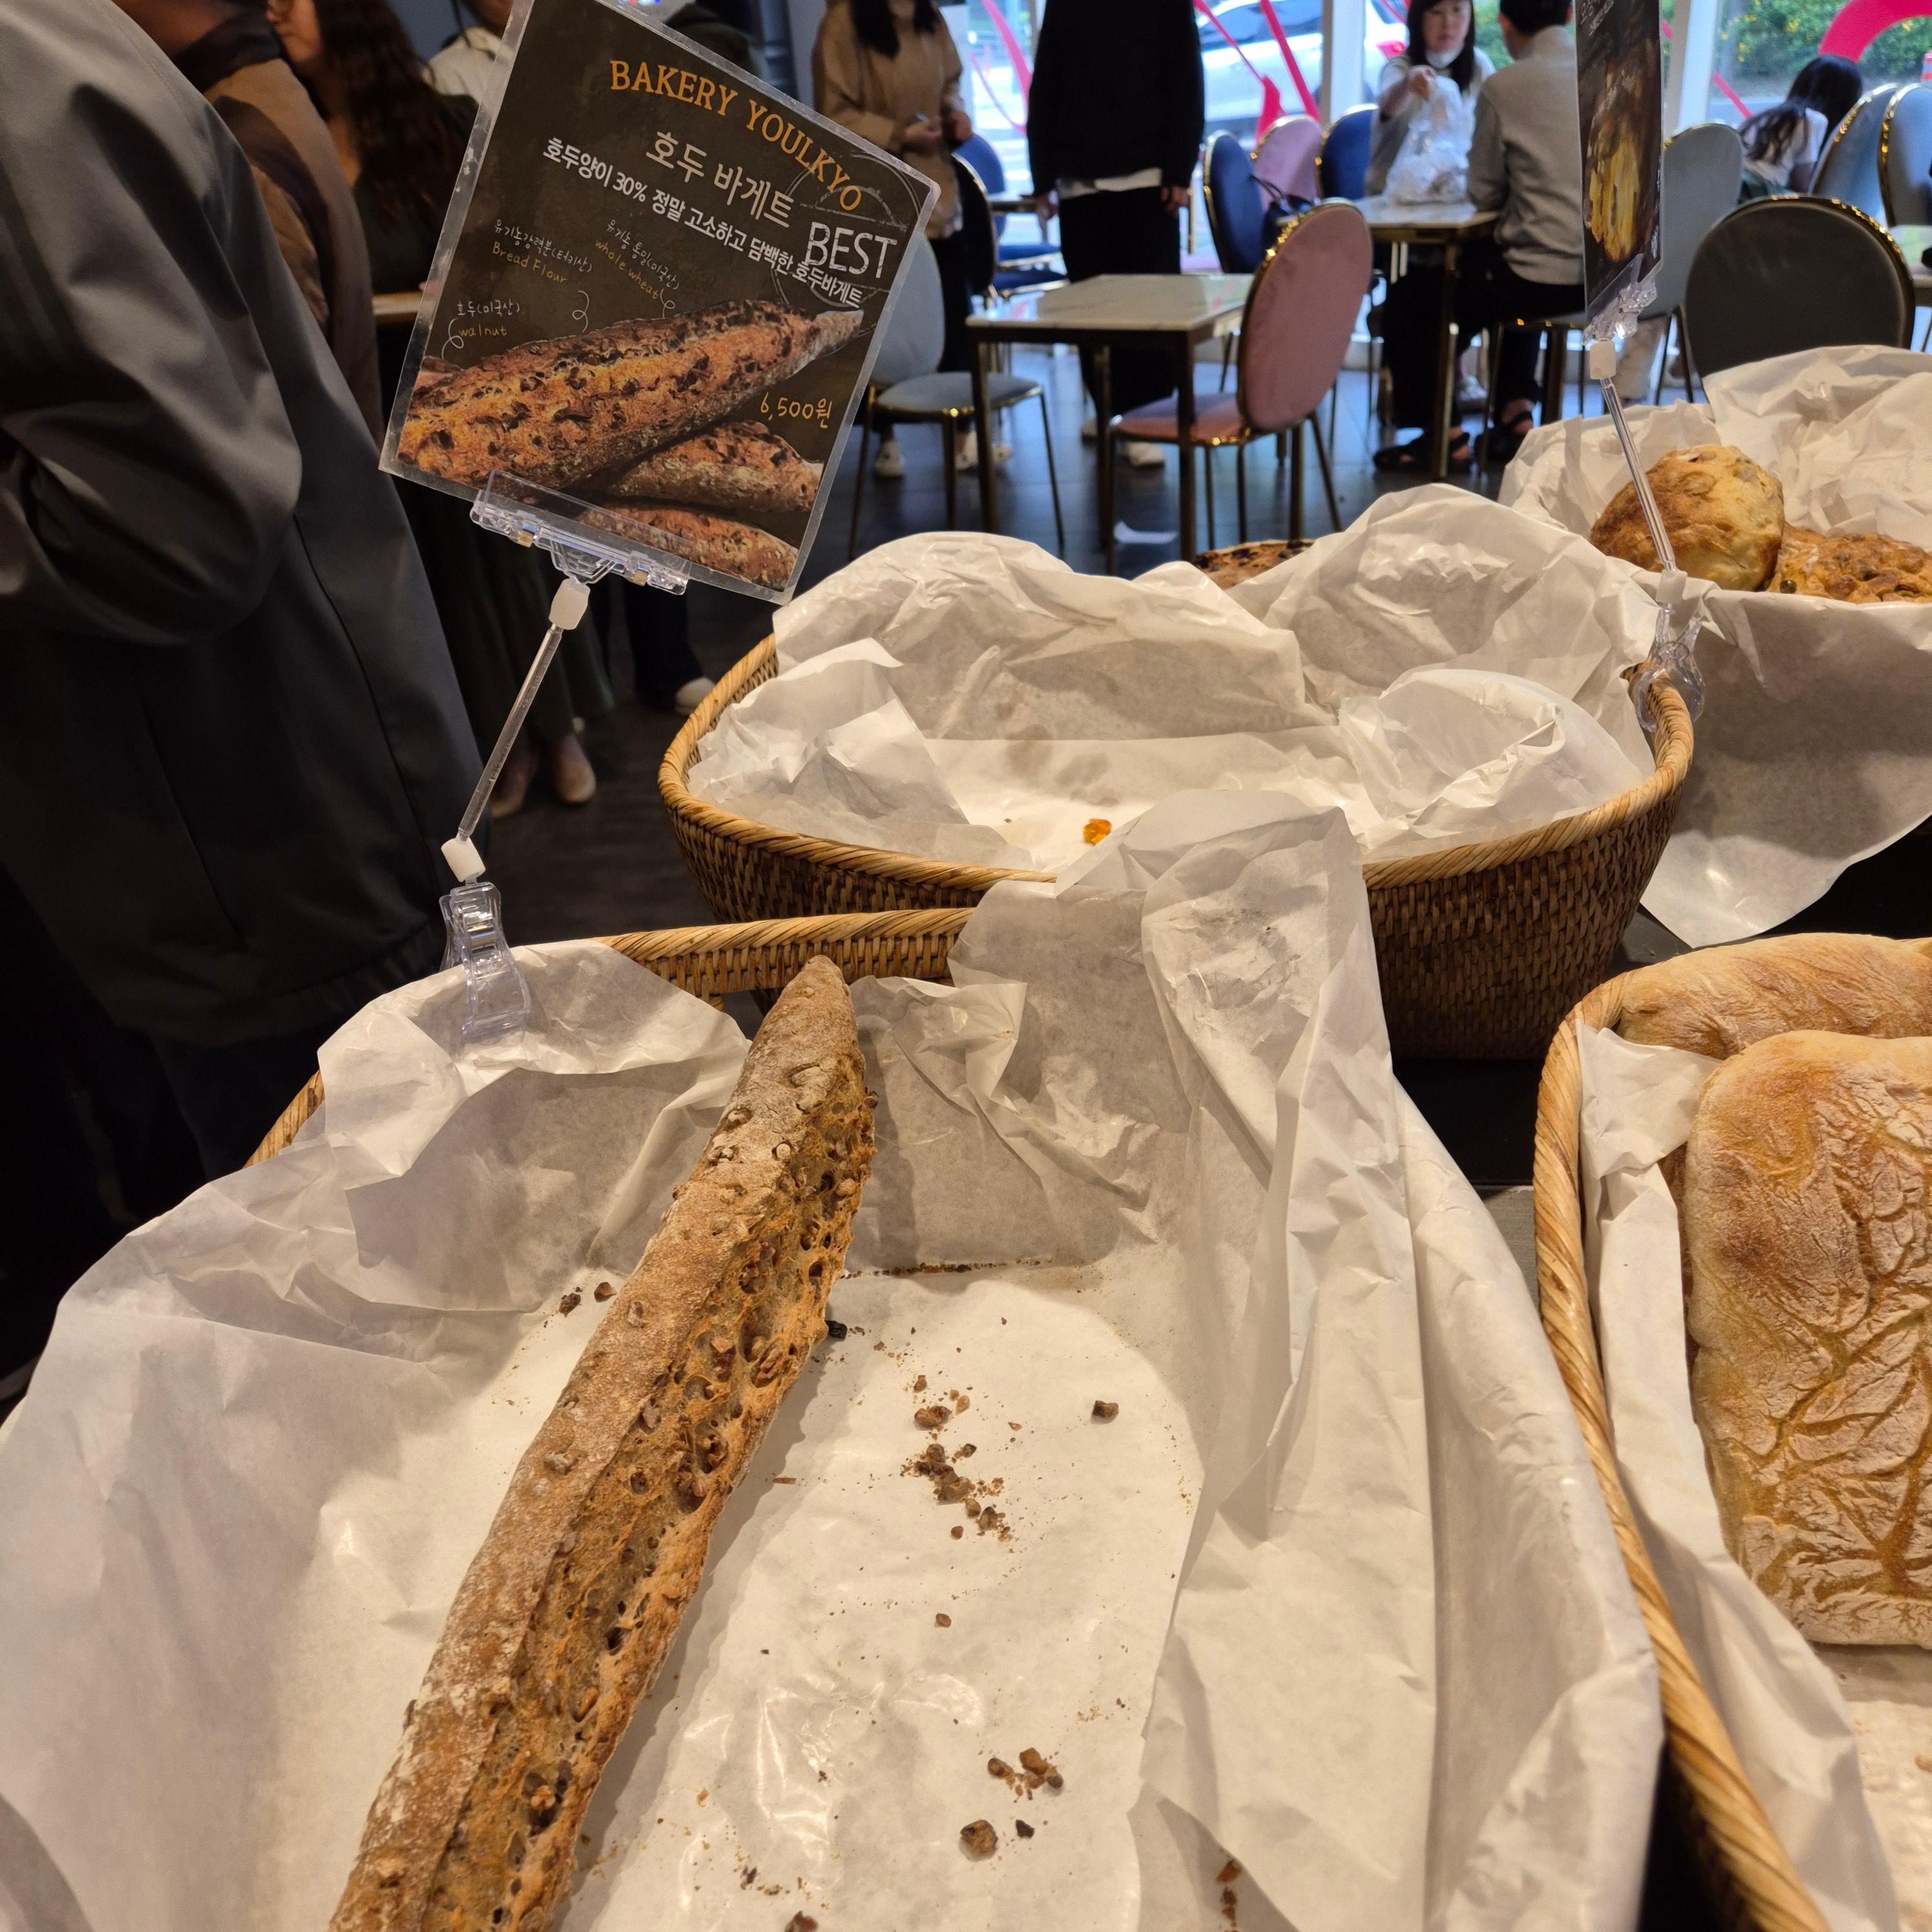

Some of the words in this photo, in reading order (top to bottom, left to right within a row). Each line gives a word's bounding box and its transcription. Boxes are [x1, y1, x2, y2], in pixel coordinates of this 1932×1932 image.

[610, 60, 739, 116] BAKERY
[746, 99, 862, 211] YOULKYO
[646, 132, 707, 183] 호두
[714, 163, 794, 228] 바게트
[543, 137, 613, 187] 호두양이
[613, 171, 648, 202] 30%
[652, 189, 686, 222] 정말
[684, 207, 747, 252] 고소하고
[748, 237, 794, 275] 담백한
[792, 260, 863, 309] 호두바게트
[607, 219, 631, 249] 유기농
[493, 241, 530, 268] Bread
[533, 258, 567, 284] Flour
[595, 240, 626, 270] whole
[628, 269, 659, 299] wheat
[804, 221, 898, 278] BEST
[457, 298, 520, 317] 호두(미국산)
[458, 324, 508, 337] walnut
[761, 392, 832, 429] 6,500원
